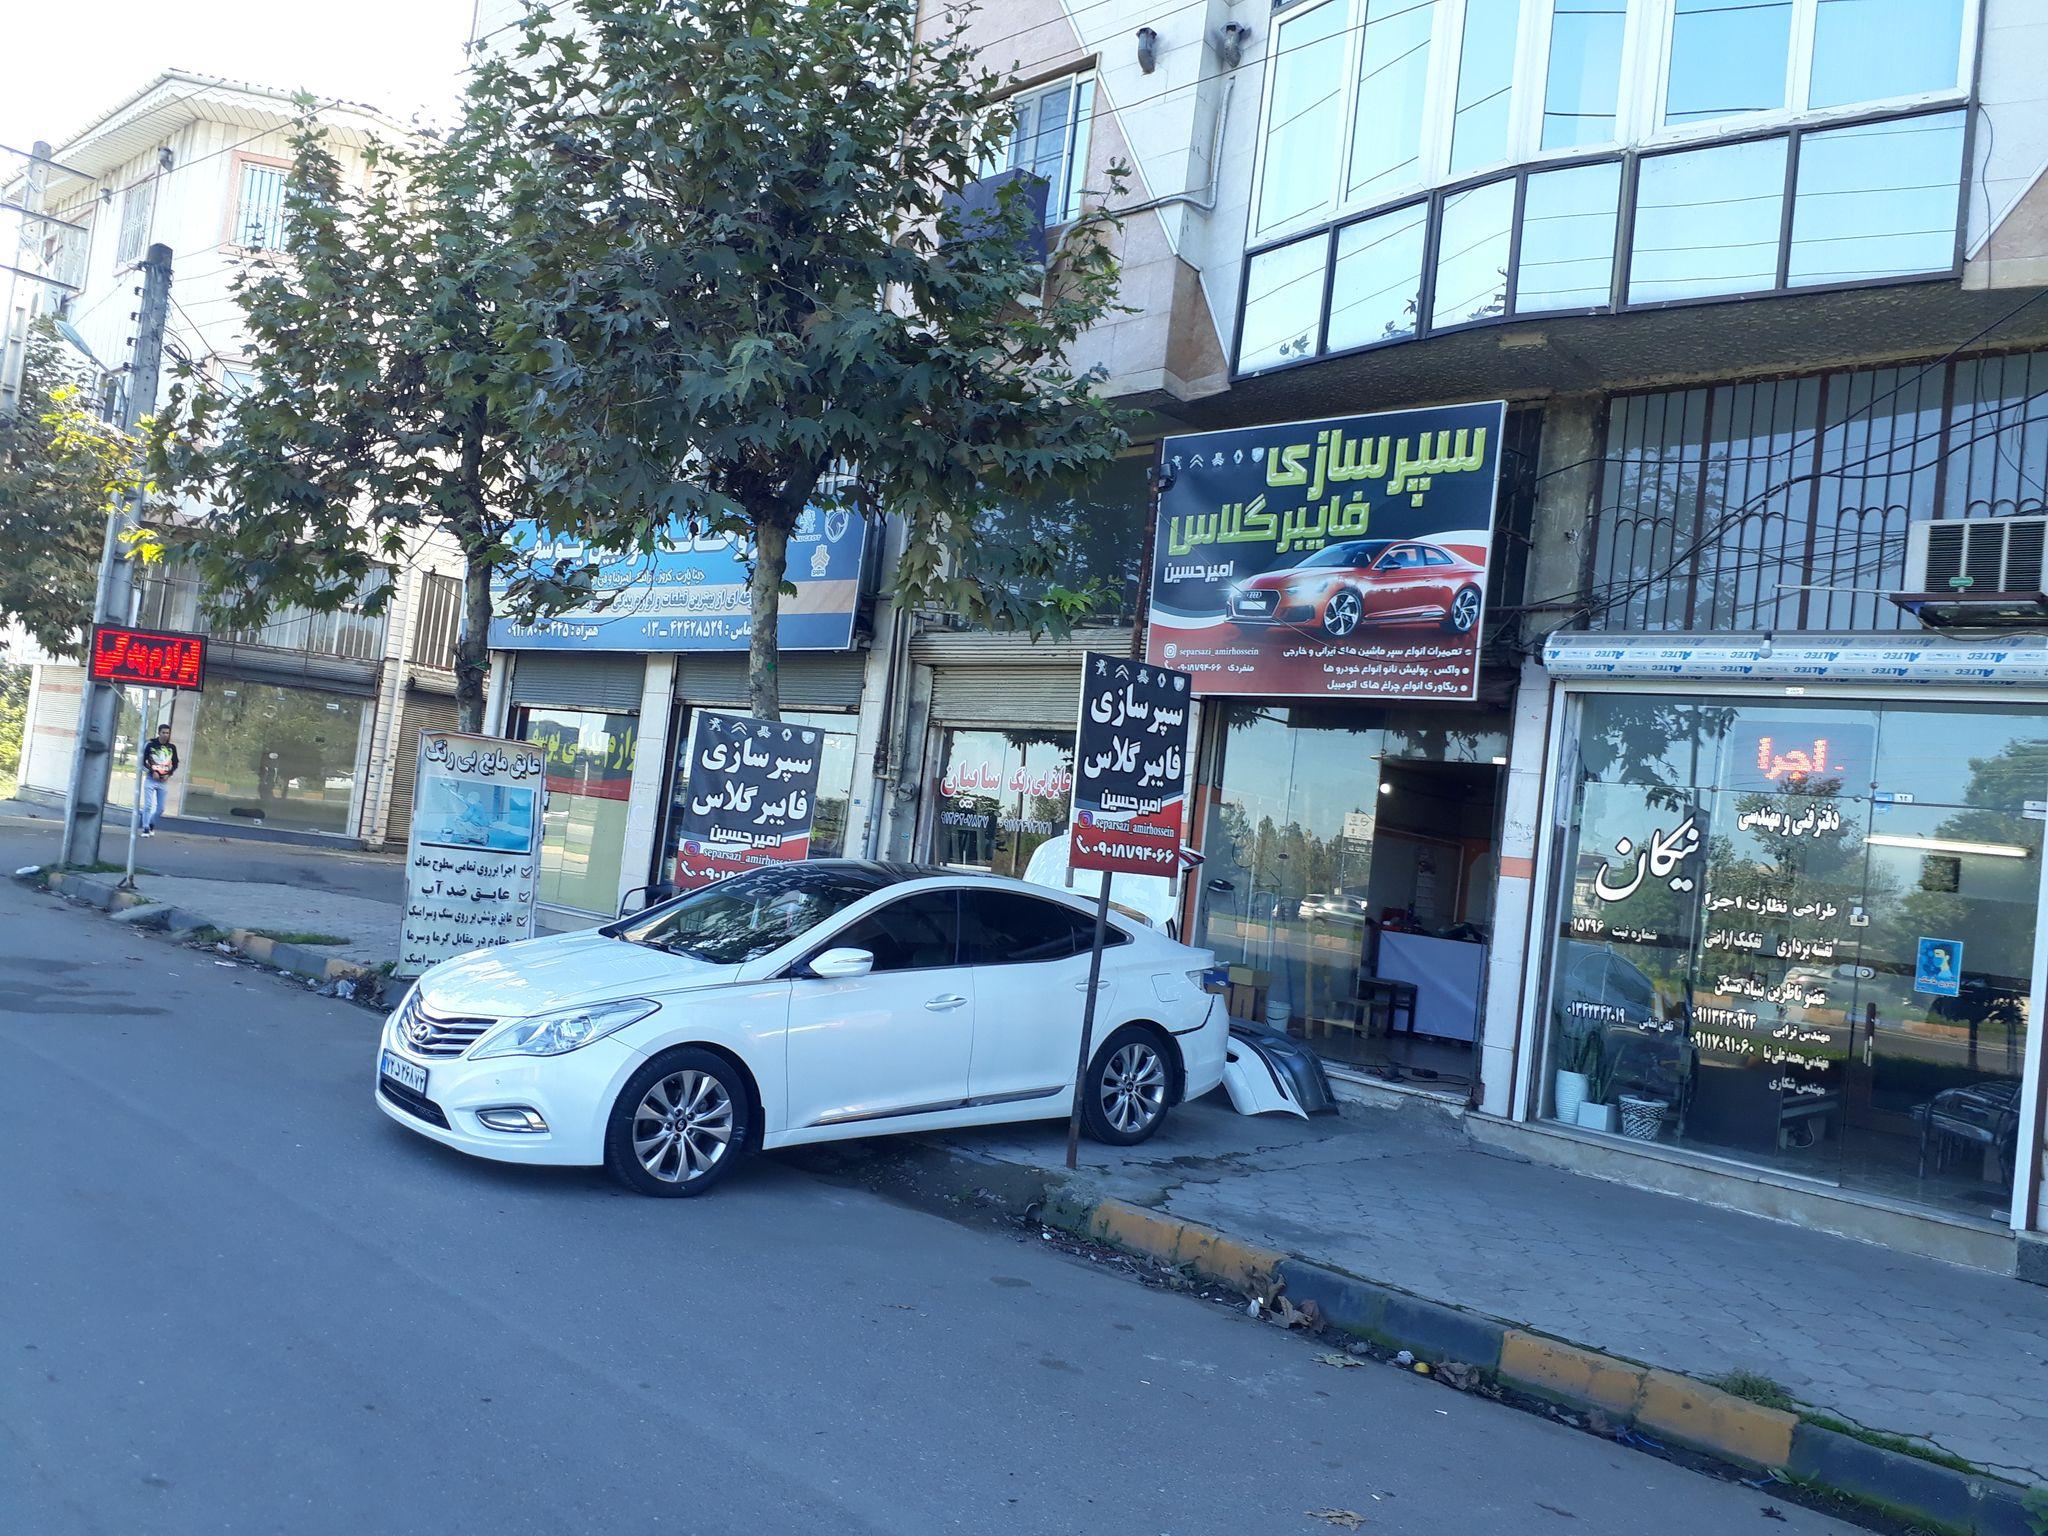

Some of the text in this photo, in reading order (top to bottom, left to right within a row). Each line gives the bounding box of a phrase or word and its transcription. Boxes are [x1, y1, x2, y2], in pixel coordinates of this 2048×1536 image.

[1266, 427, 1487, 507] سپر سازی
[1168, 491, 1370, 556] فایبر گلاس
[1283, 646, 1306, 657] خارجی
[1315, 647, 1336, 657] ایرانی
[1338, 647, 1356, 656] های
[1358, 647, 1385, 657] ماشین
[1387, 649, 1403, 659] سپر
[1405, 647, 1425, 657] انواع
[1427, 647, 1462, 657] تعمیرات
[1594, 650, 2008, 663] ALTEC ALTEC ALTEC ALTEC ALTEC ALTEC
[1336, 665, 1359, 675] خودرو
[1361, 665, 1381, 675] انواع
[1383, 665, 1398, 675] نانو
[1400, 666, 1428, 677] پولیش
[1434, 665, 1460, 675] واکس
[1586, 664, 1994, 677] ALTEC ALTEC ALTEC ALTEC ALTEC ALTEC
[1327, 680, 1457, 693] ریکاوری انواع چراغ های اتومبیل
[1090, 683, 1183, 736] سپر سازی
[425, 740, 540, 779] عایق مایع بی رنگ
[702, 737, 812, 782] سپر سازی
[1084, 735, 1181, 787] فایبر گلاس
[691, 780, 808, 825] فایبر گلاس
[1738, 803, 1840, 837] دفتر فنی و مهندسی
[1095, 818, 1175, 838] separsazi_amirhossein
[415, 854, 431, 867] صاف
[432, 858, 454, 871] سطوح
[1595, 815, 1700, 902] نیکان
[422, 880, 510, 903] عایق ضد آب
[1703, 892, 1837, 920] طراحی نظارت اجرا
[1573, 917, 1658, 942] شماره ثبت ۱۵۲۹۶
[1704, 929, 1733, 949] اراضی
[1734, 931, 1763, 951] تفکیک
[1714, 977, 1826, 1009] عضو ناظرین بنیاد مسکن
[1638, 1016, 1658, 1030] تماس
[1659, 1019, 1674, 1032] تلفن
[1772, 1024, 1798, 1040] ترابی
[1799, 1030, 1831, 1044] مهندس
[1804, 1055, 1830, 1072] مهندس
[1796, 1082, 1825, 1097] مهندس
